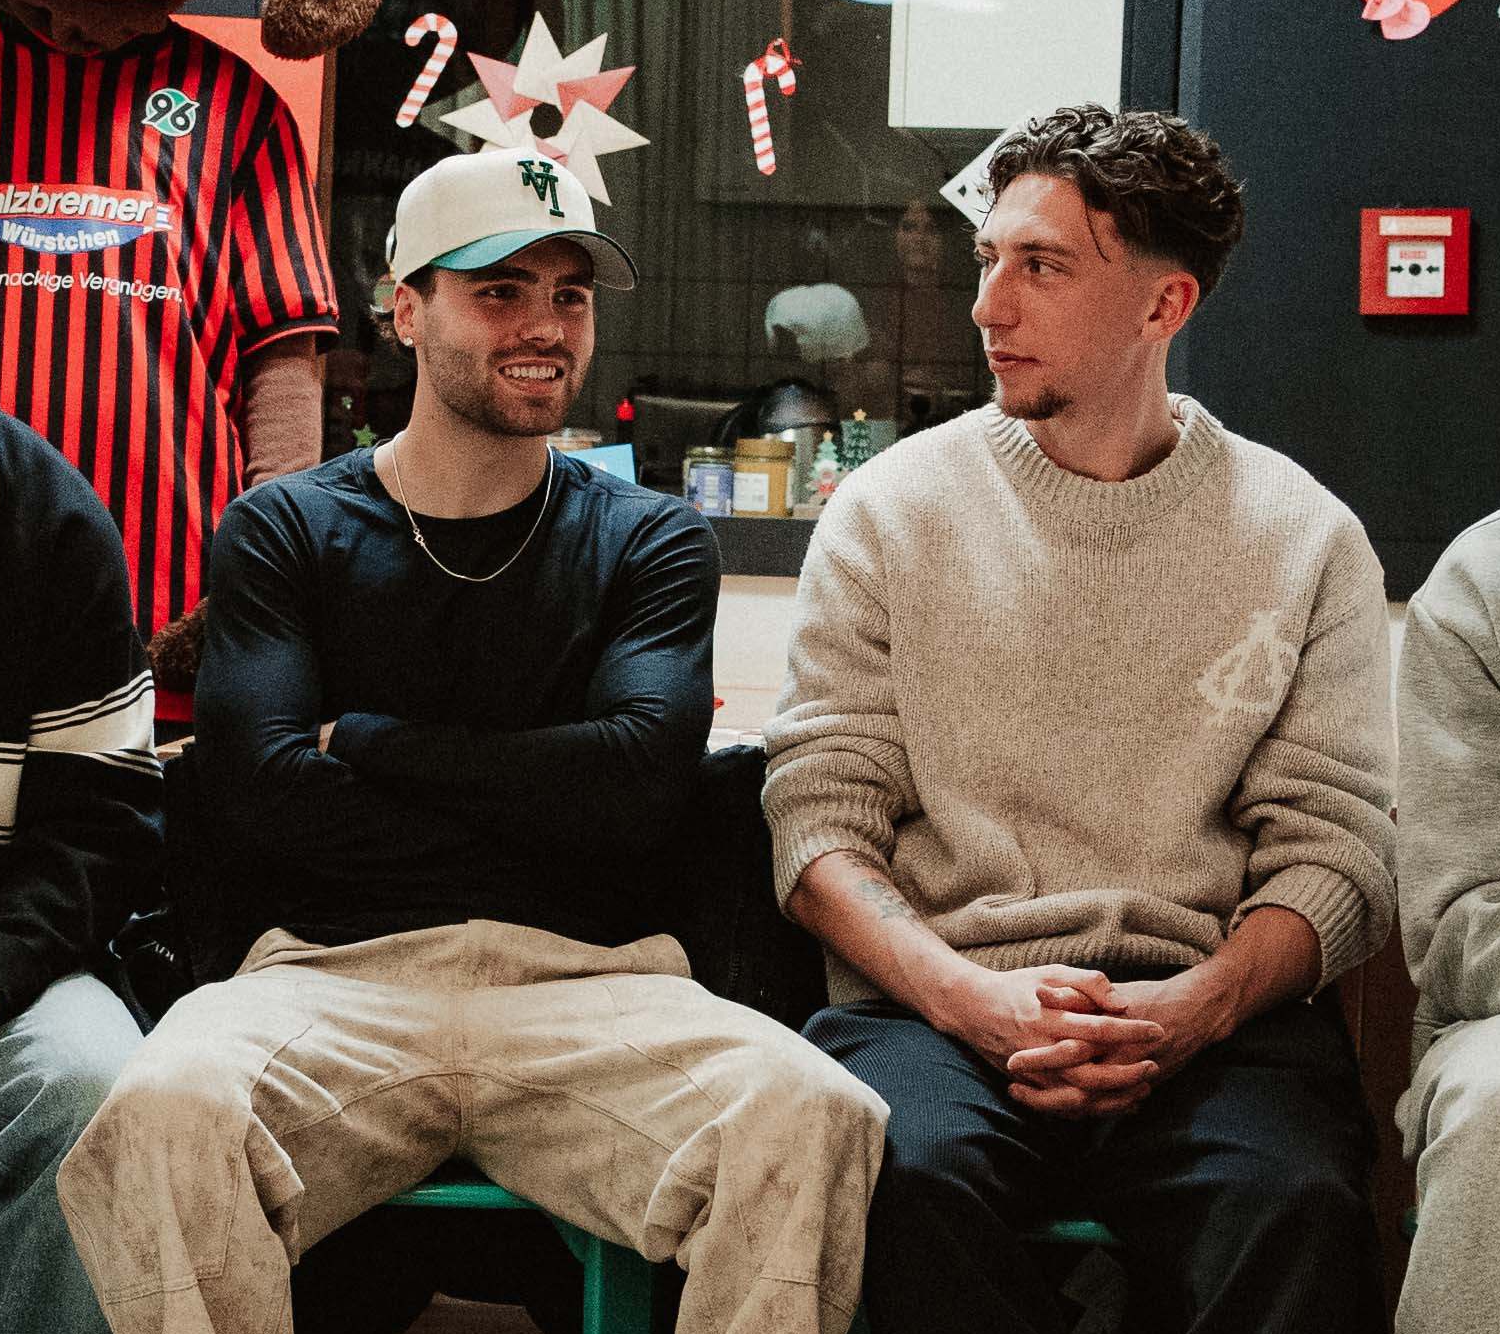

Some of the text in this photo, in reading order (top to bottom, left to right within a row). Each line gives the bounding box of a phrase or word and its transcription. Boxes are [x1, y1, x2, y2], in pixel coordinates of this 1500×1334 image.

[142, 90, 199, 134] 96
[1, 220, 121, 251] Würstchen
[79, 271, 184, 303] Vergnügen.
